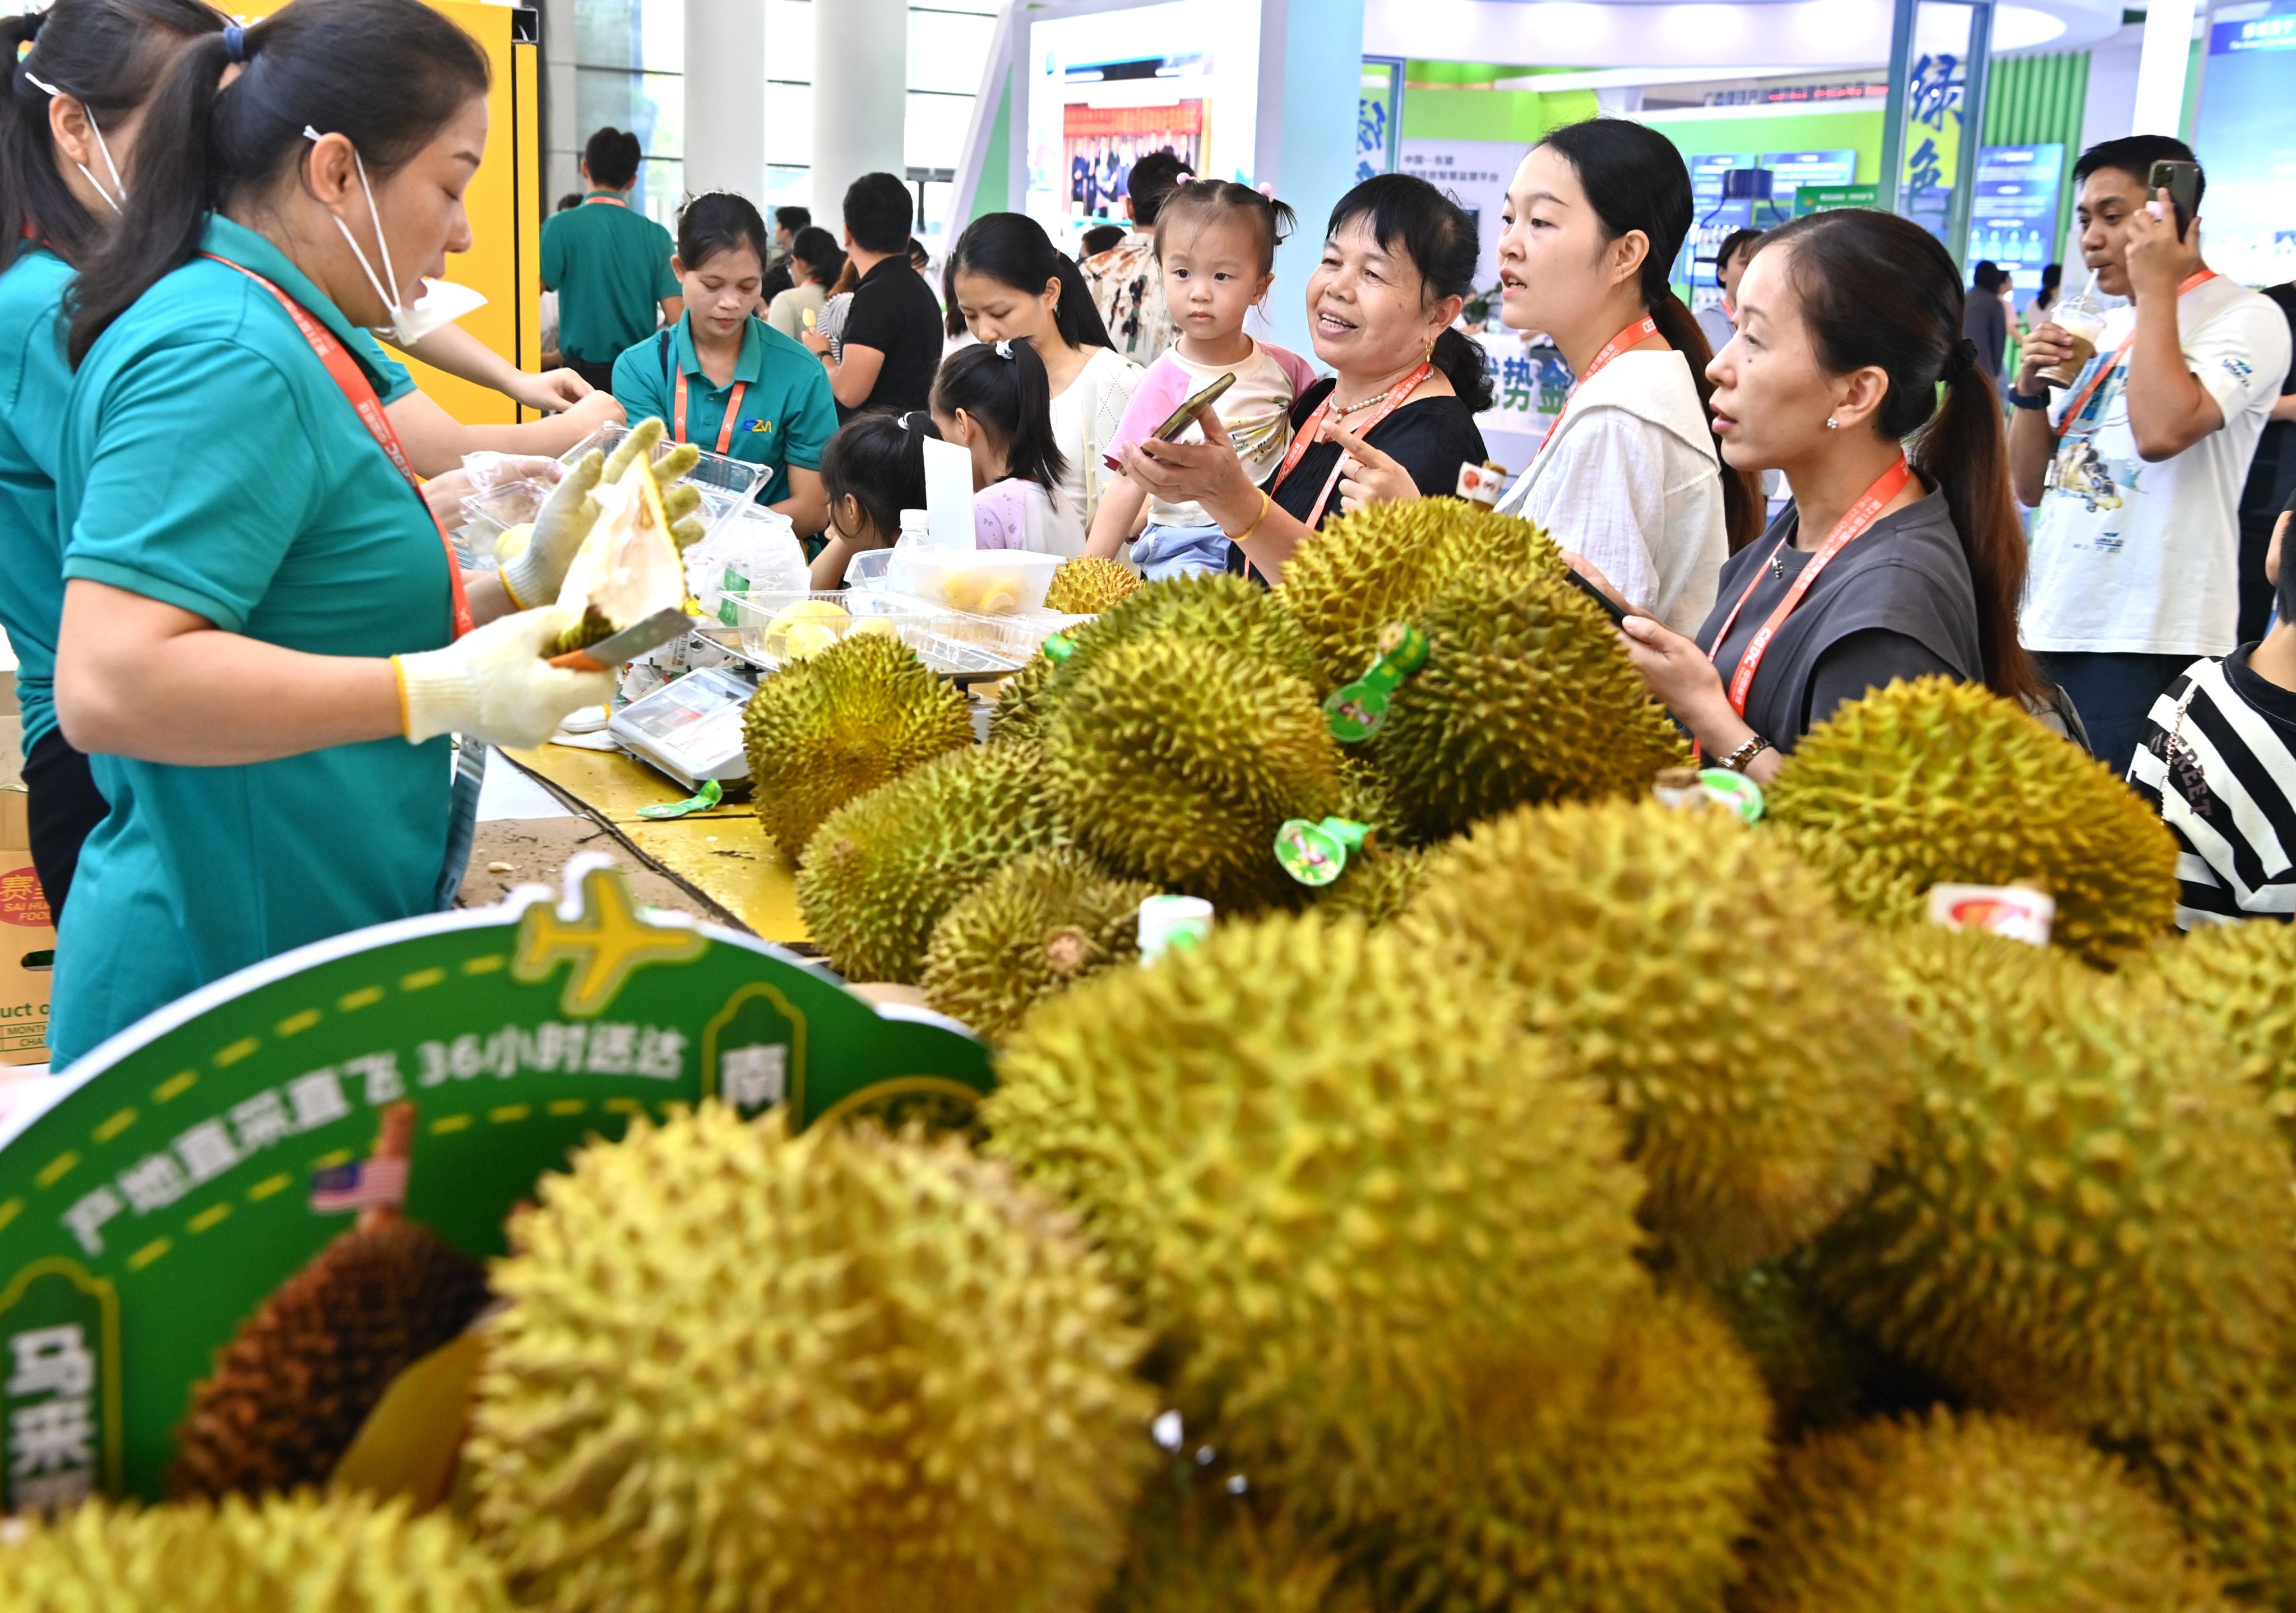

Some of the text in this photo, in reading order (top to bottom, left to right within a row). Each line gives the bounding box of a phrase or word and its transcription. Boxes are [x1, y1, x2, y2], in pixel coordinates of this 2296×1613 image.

[1909, 54, 1966, 214] 绿色
[415, 1021, 688, 1088] 36小时送达
